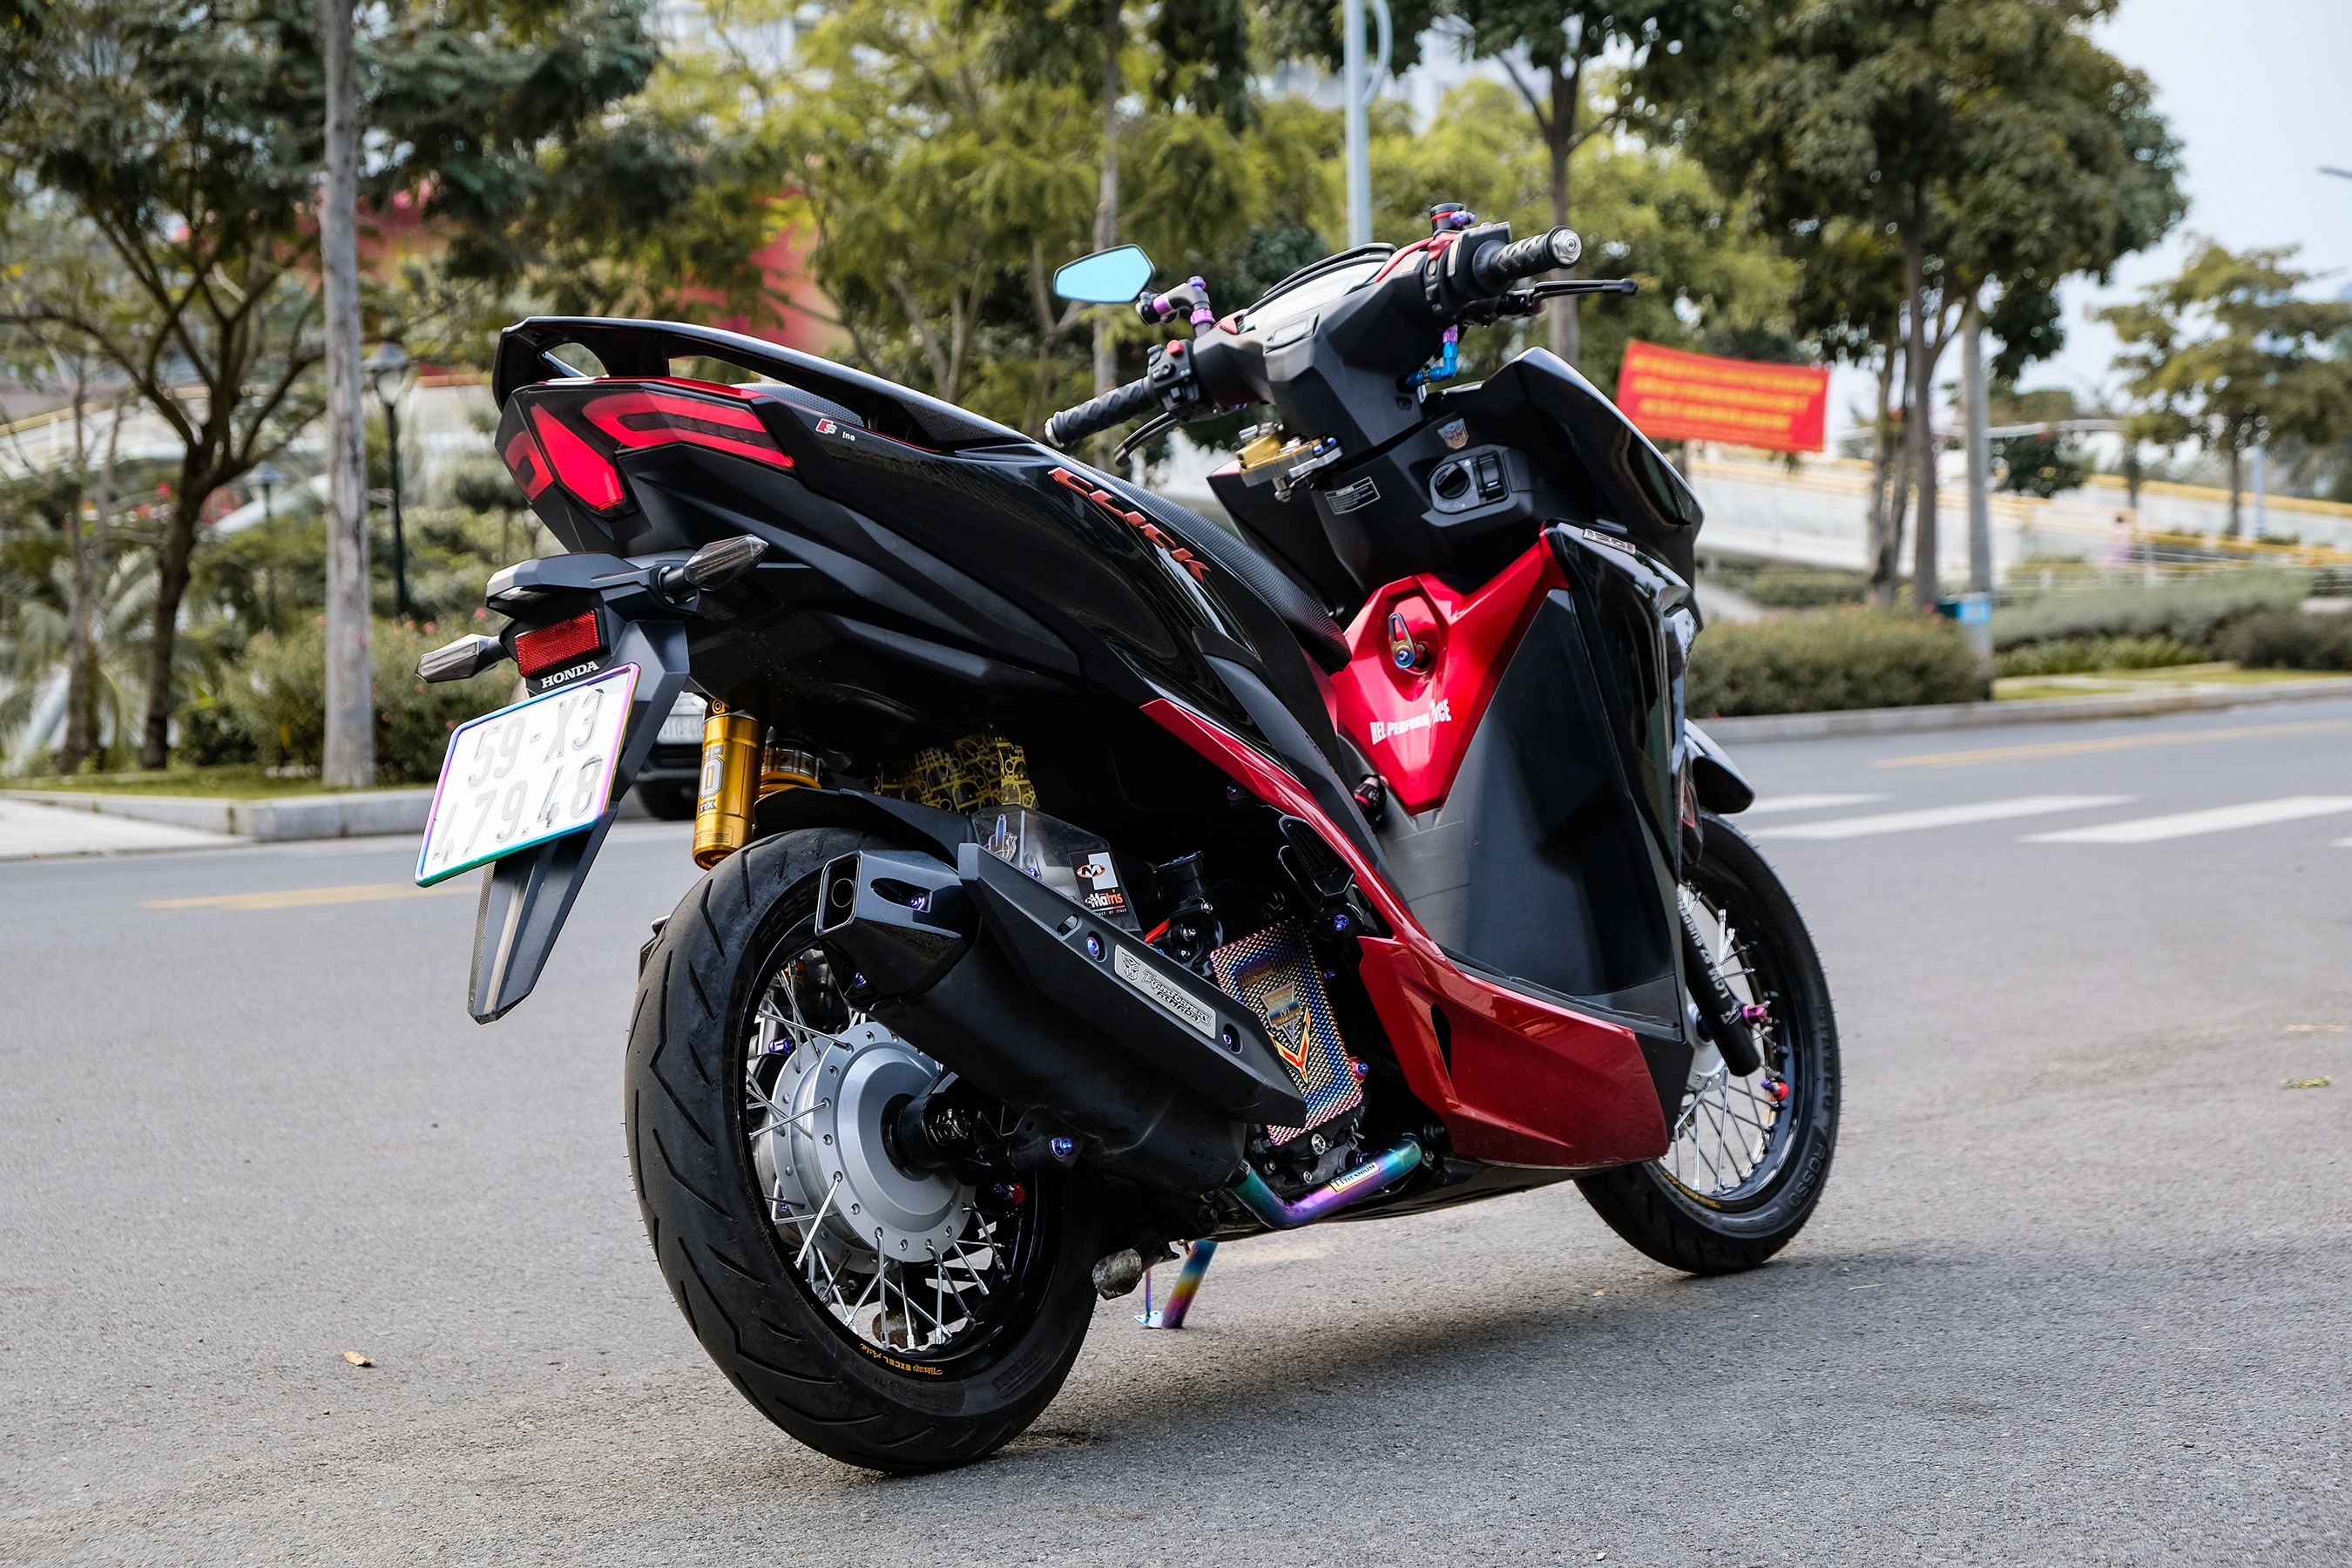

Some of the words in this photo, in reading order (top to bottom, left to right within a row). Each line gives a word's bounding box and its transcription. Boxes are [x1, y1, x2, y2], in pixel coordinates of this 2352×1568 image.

[1048, 467, 1211, 584] CLICK
[541, 661, 599, 689] HONDA
[468, 688, 605, 787] 59-X3
[1369, 721, 1387, 745] HEL
[432, 754, 603, 864] 479.48
[1344, 1164, 1375, 1183] TITANIUM
[1788, 1141, 1828, 1207] ROSSO
[882, 1355, 912, 1372] EXCEL
